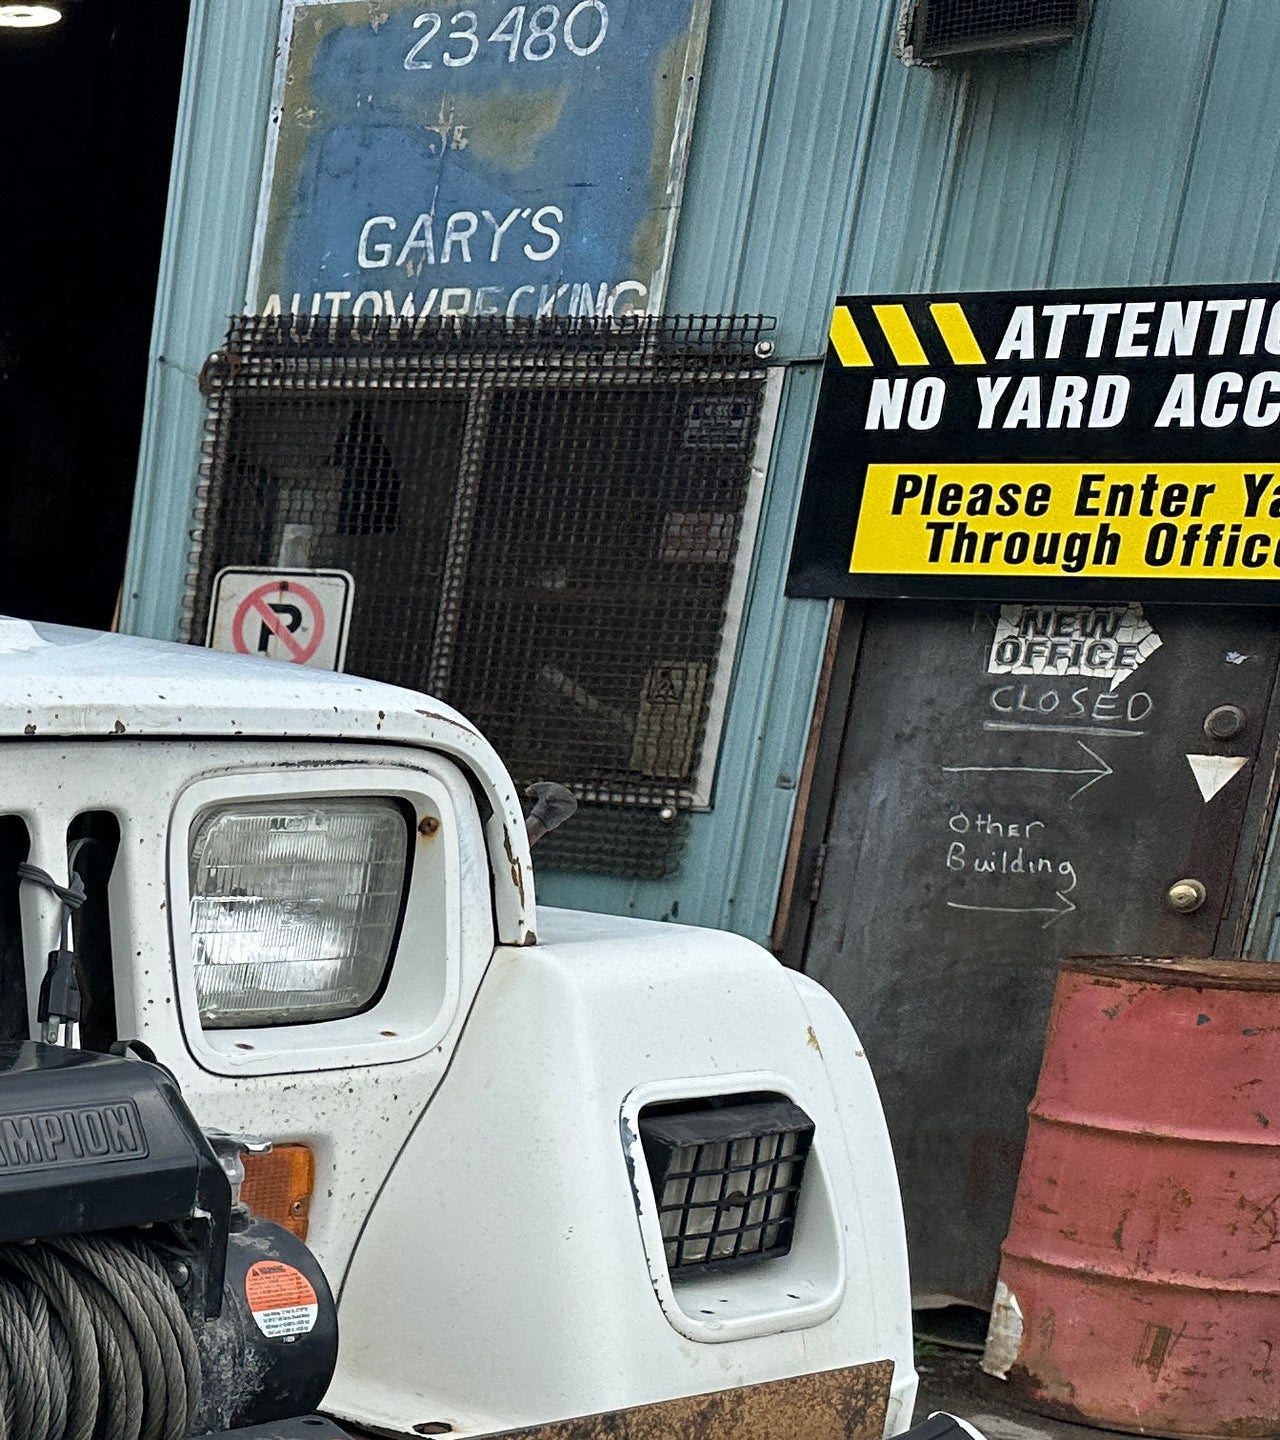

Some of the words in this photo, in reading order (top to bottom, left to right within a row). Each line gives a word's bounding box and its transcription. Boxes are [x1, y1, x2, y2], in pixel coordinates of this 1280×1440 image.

[403, 0, 609, 71] 23480
[357, 205, 564, 269] GARY'S
[260, 280, 648, 342] AUTOWRECKING
[865, 376, 946, 431] NO
[977, 374, 1130, 430] YARD
[892, 473, 1051, 517] Please
[1075, 473, 1215, 518] Enter
[925, 522, 1122, 573] Through
[1144, 522, 1280, 568] Offic
[1020, 608, 1121, 638] NEW
[995, 635, 1139, 669] OFFICE
[992, 684, 1152, 721] CLOSED
[946, 841, 1077, 893] Building
